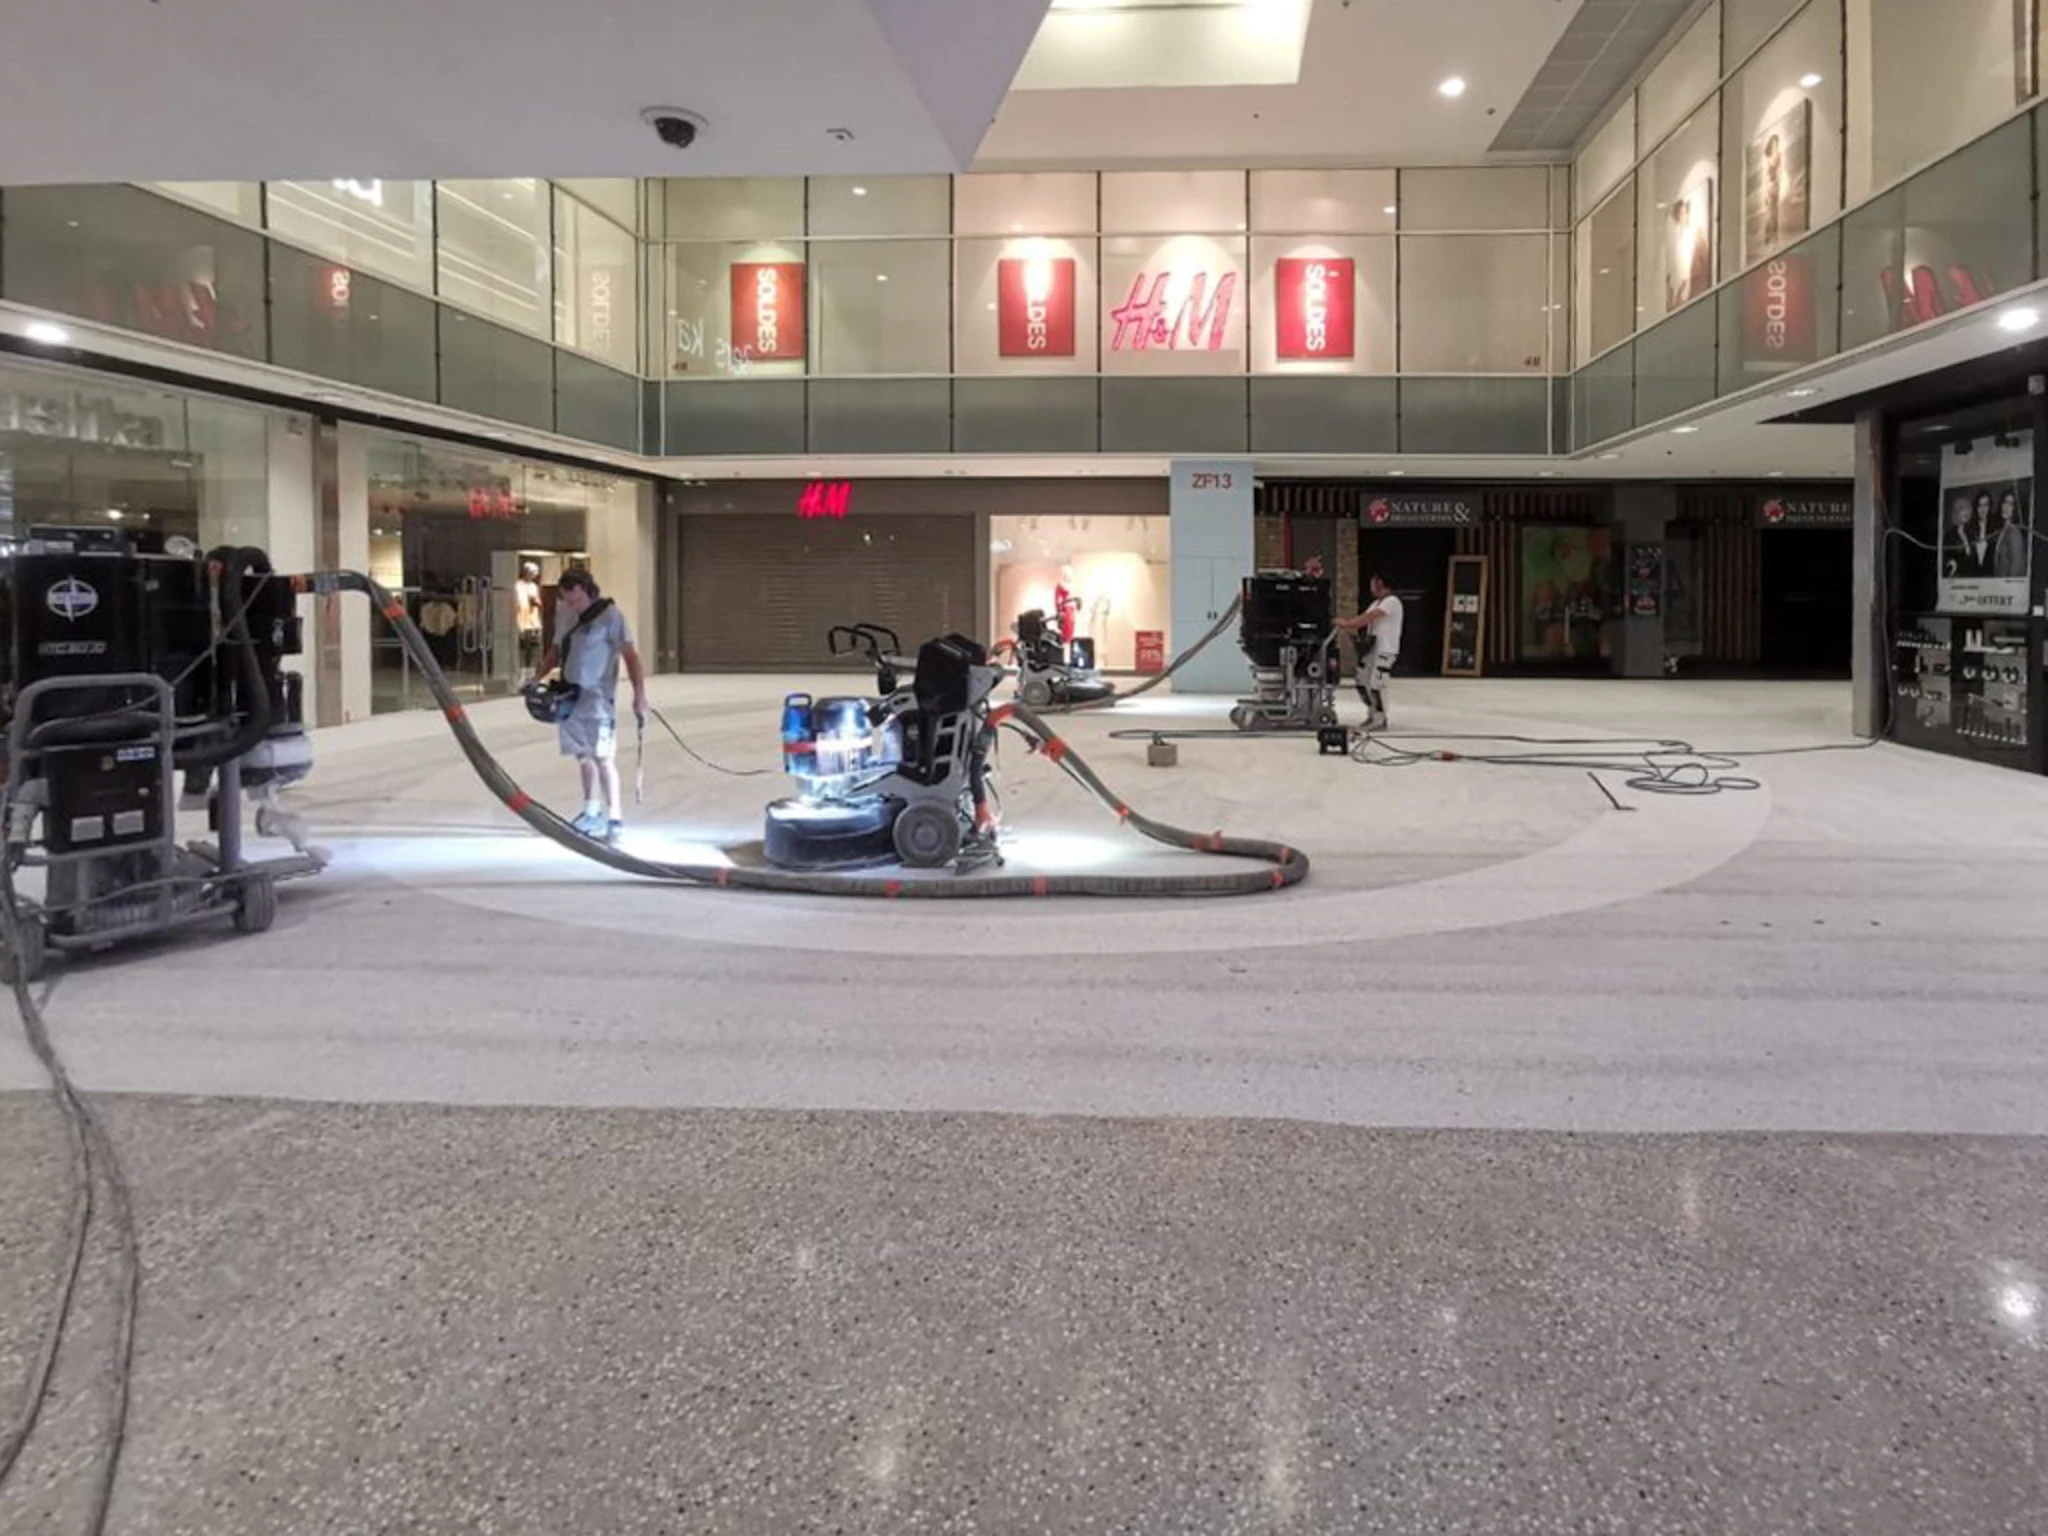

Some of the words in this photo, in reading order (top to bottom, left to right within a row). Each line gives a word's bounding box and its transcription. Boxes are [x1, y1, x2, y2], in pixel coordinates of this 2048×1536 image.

[756, 267, 778, 353] SOLDES
[1110, 272, 1236, 351] H&M
[1305, 263, 1327, 352] SOLDES
[1191, 472, 1233, 490] ZF13
[1390, 501, 1453, 513] NATURE
[1453, 501, 1472, 523] &
